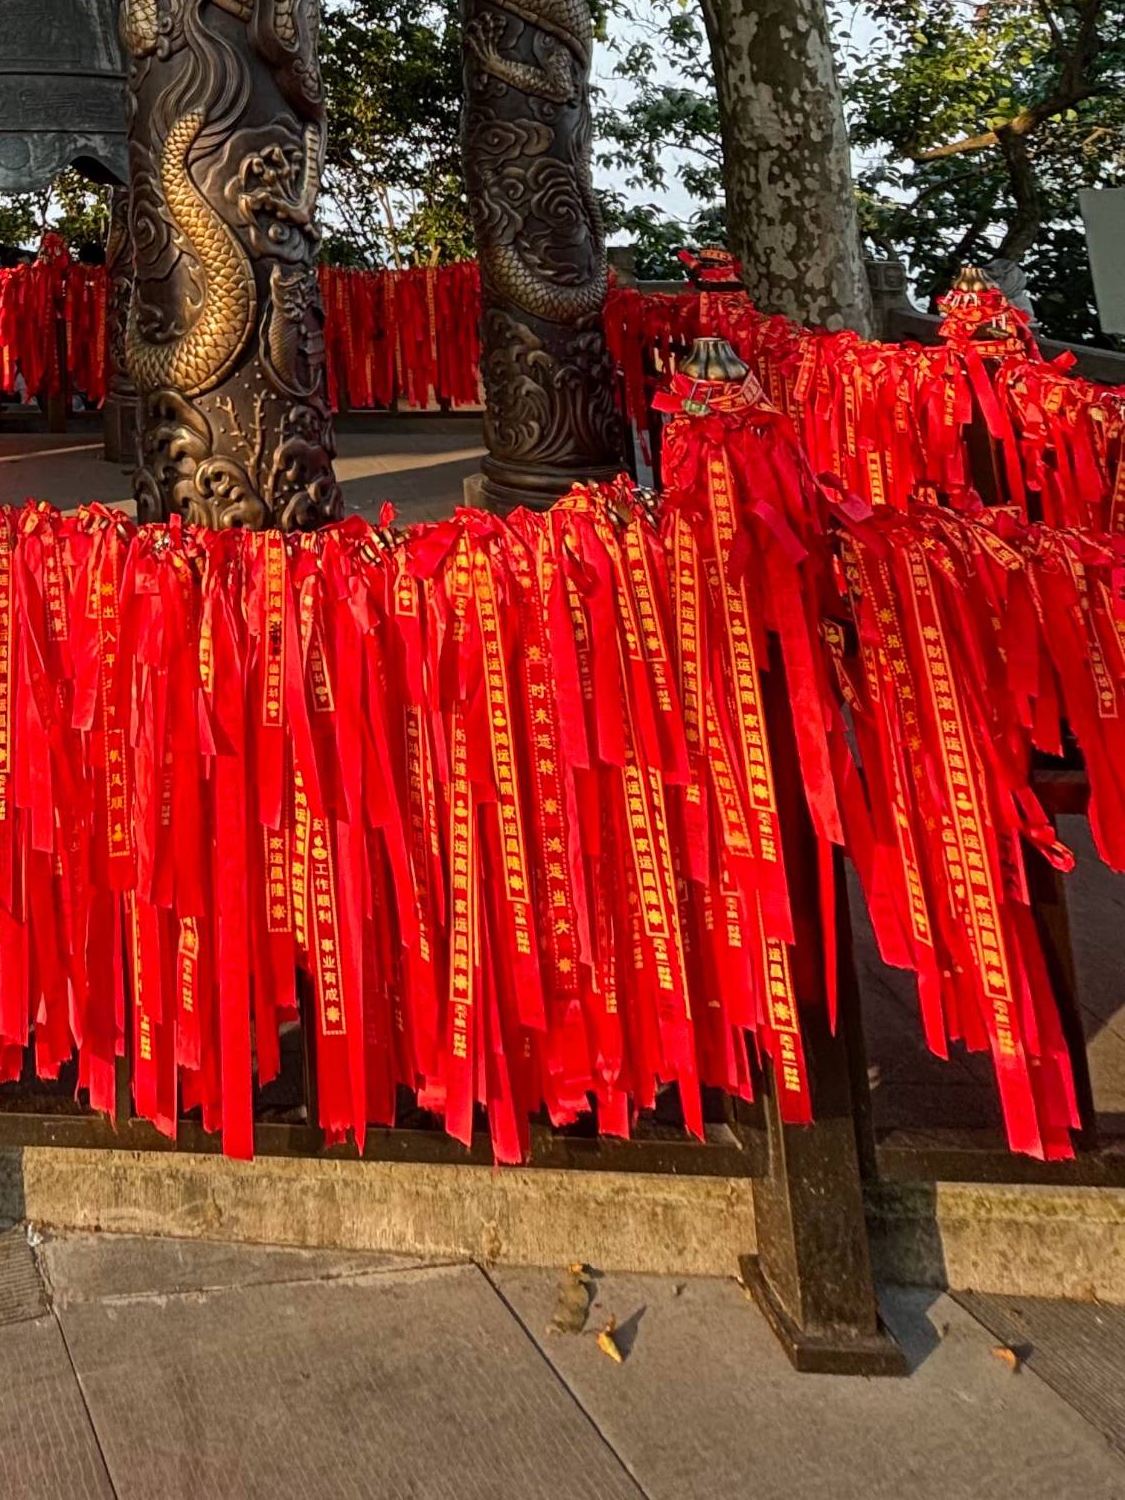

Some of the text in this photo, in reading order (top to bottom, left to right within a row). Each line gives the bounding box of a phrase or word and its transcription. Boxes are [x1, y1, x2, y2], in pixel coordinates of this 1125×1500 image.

[486, 640, 505, 704] 好运连连
[531, 684, 556, 776] 时来运转
[744, 711, 768, 783] 家运昌隆
[941, 719, 968, 787] 好运连连
[268, 836, 286, 898] 家运昌隆
[453, 823, 470, 889] 鸿运高照
[314, 864, 332, 925] 工作顺利
[453, 900, 469, 971] 家运昌隆
[320, 938, 340, 1001] 事业有成
